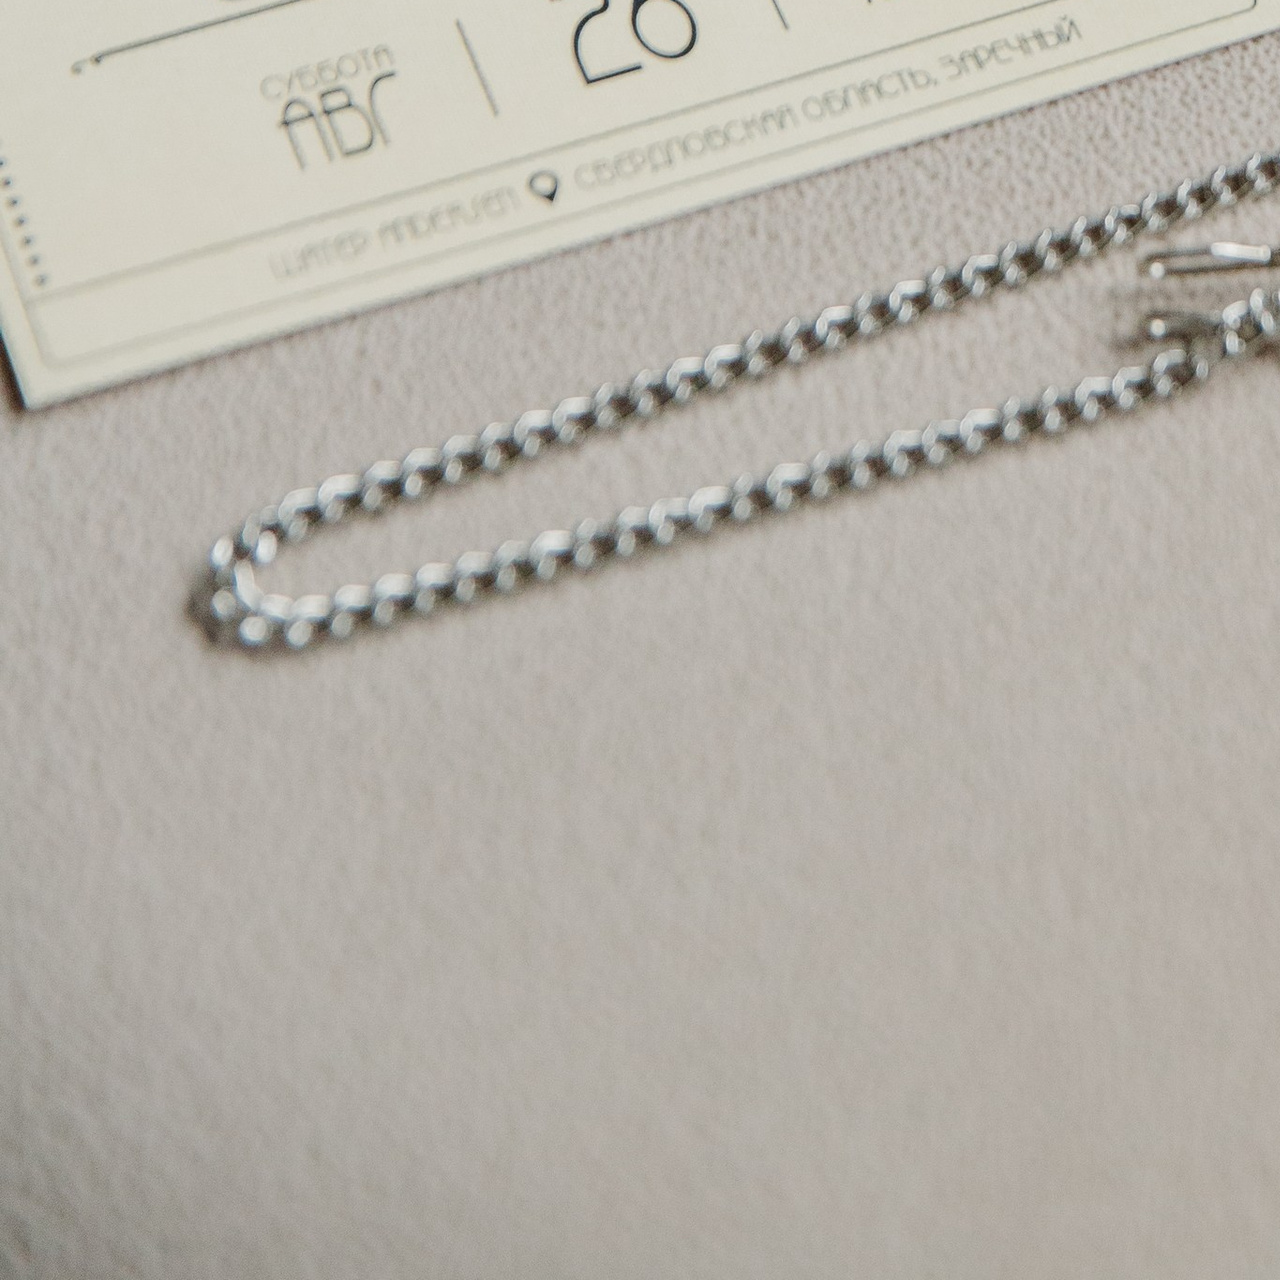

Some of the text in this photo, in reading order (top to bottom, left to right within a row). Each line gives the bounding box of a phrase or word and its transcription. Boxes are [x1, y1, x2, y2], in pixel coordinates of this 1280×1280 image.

[259, 43, 395, 101] СУББОТА
[278, 70, 396, 170] АВГ
[573, 101, 798, 192] СВЕРДЛОВСКАЯ
[801, 65, 939, 122] ОБЛАСТЬ,
[944, 13, 1084, 82] ЗАРЕЧНЫЙ
